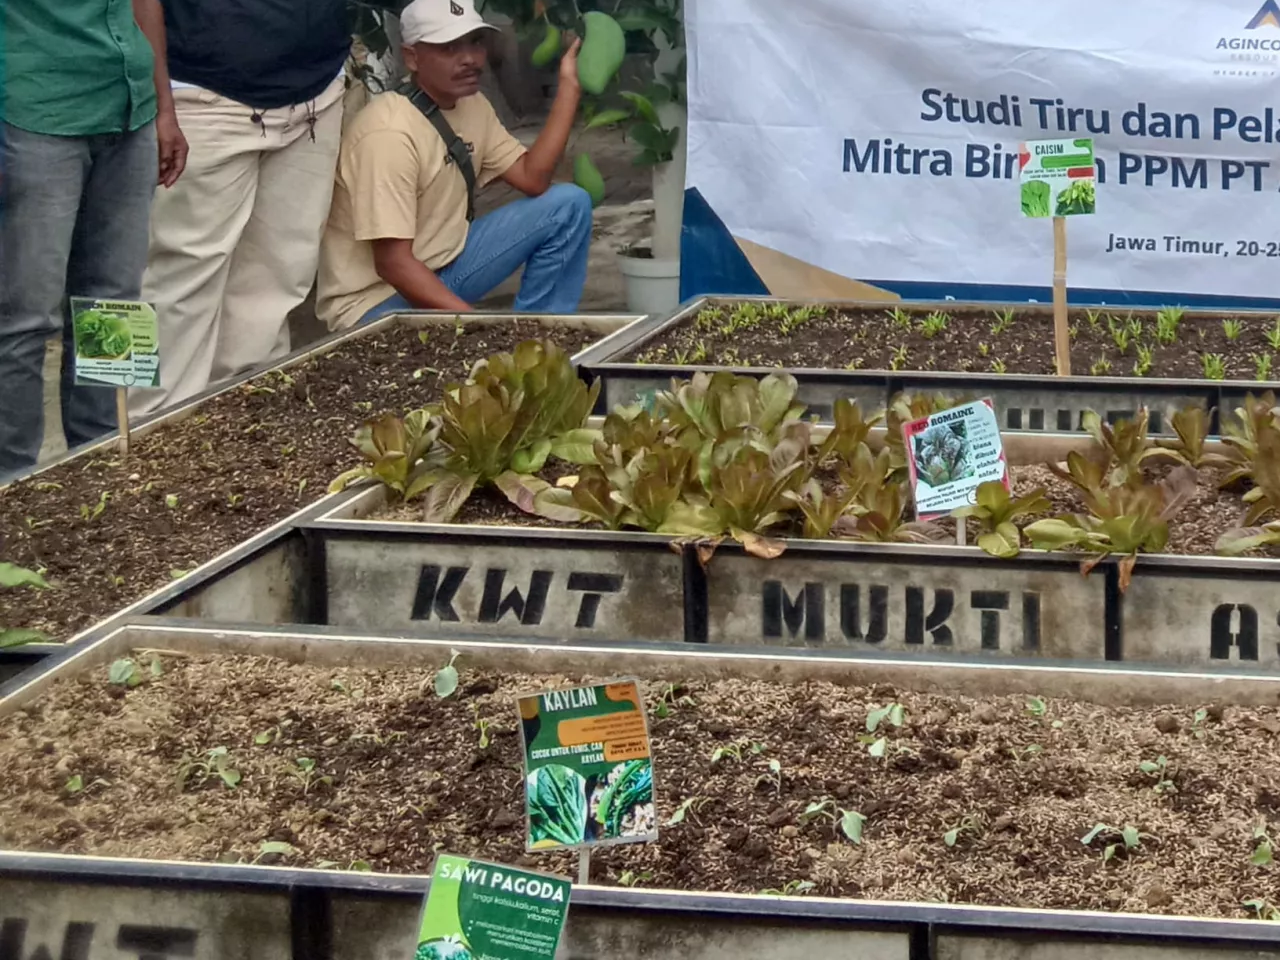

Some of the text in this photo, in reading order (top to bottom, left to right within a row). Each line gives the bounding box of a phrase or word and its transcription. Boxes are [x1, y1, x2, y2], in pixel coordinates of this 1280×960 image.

[921, 88, 1022, 128] Studi
[1030, 98, 1111, 135] Tiru
[1121, 102, 1200, 140] dan
[1035, 144, 1064, 155] CAISIM
[842, 137, 952, 177] Mitra
[1118, 152, 1208, 189] PPM
[1221, 160, 1270, 192] PT
[1106, 233, 1156, 253] Jawa
[1163, 236, 1229, 258] Timur,
[931, 407, 974, 426] ROMAINE
[409, 564, 624, 628] KWT
[762, 580, 1041, 650] MUKTI
[543, 687, 597, 712] KAYLAN
[440, 863, 564, 903] SAWI PAGODA
[527, 913, 553, 924] vitamin
